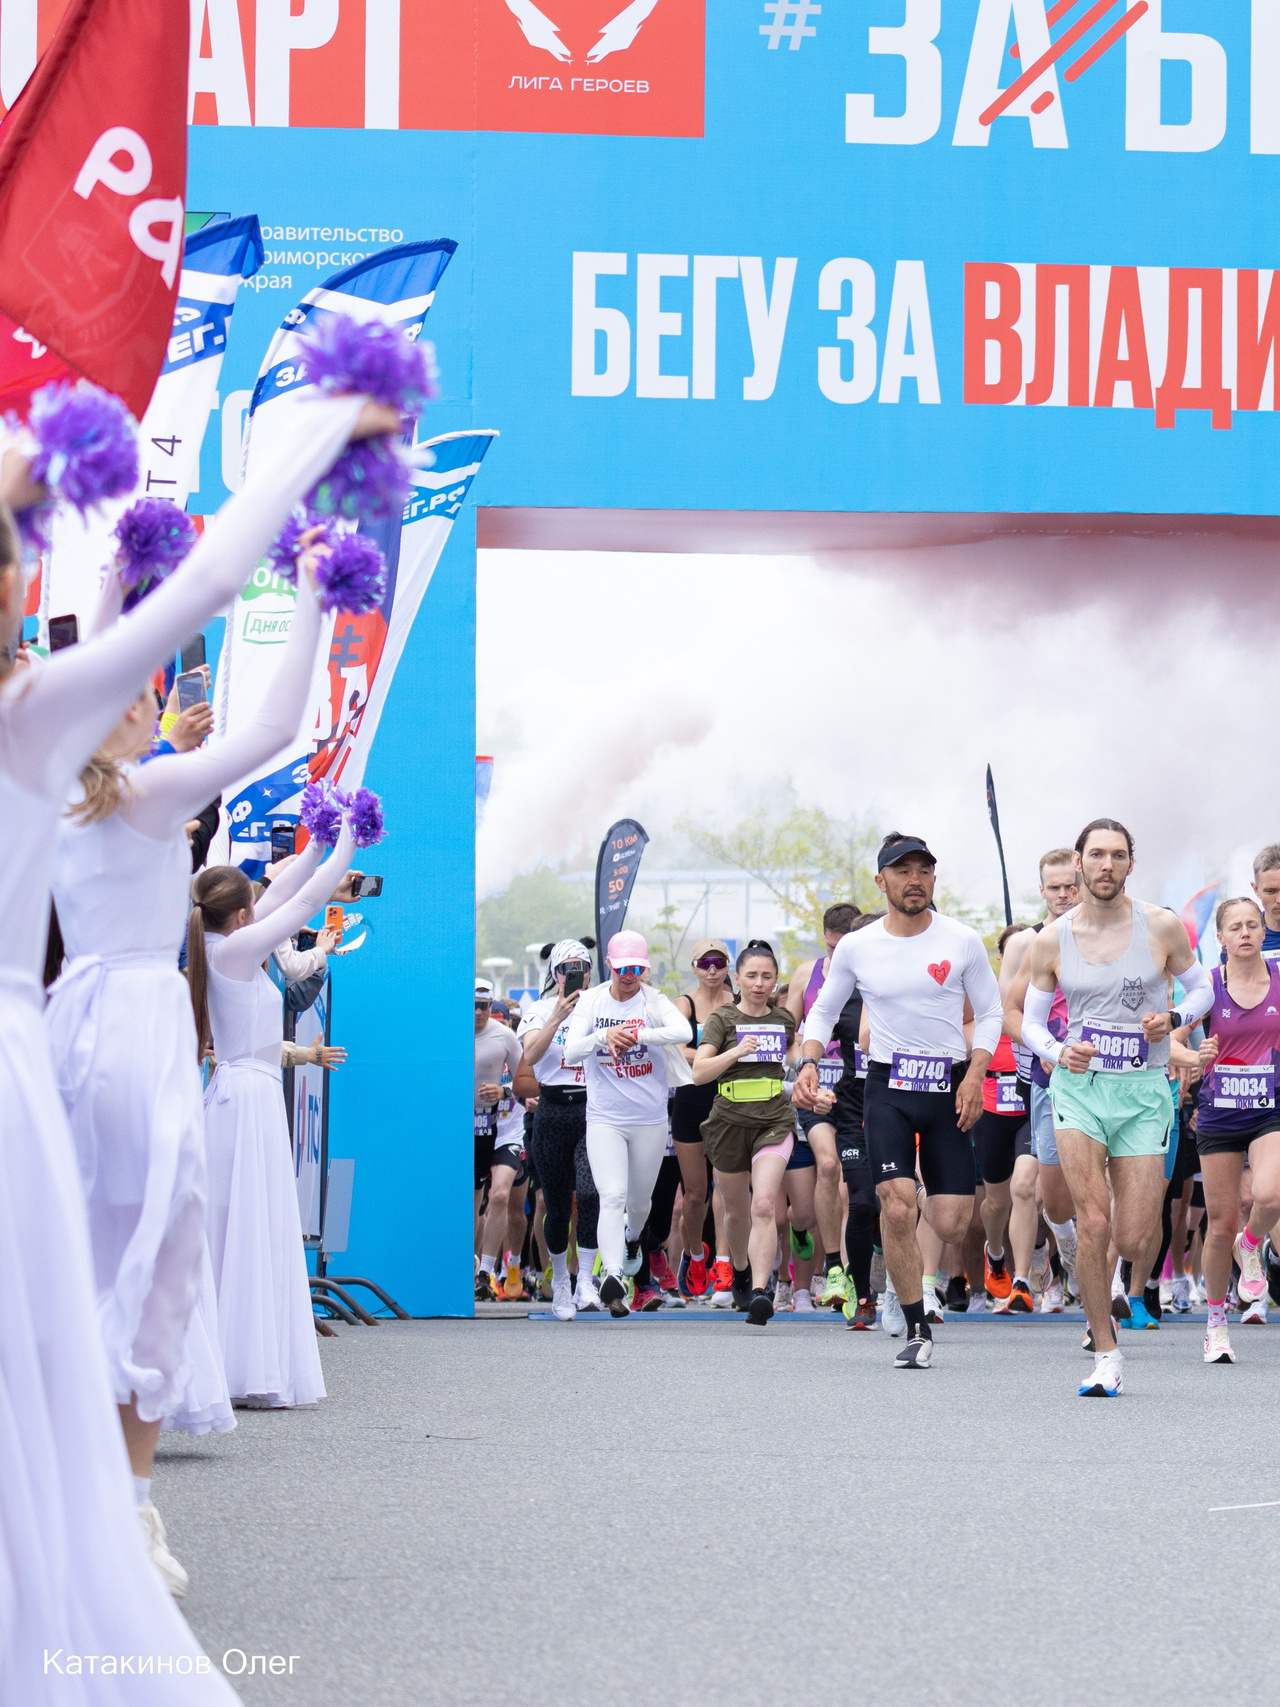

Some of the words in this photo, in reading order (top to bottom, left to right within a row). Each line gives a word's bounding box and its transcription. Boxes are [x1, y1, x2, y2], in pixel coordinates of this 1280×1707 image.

[508, 75, 563, 91] ЛИГА
[571, 77, 650, 93] ГЕРОЕВ
[262, 225, 404, 244] равительство
[263, 249, 371, 270] риморско
[243, 274, 293, 293] края
[571, 251, 798, 401] БЕГУ
[818, 257, 941, 405] ЗА
[608, 879, 625, 894] 50
[1091, 1033, 1140, 1058] 30816
[623, 1061, 653, 1079] ТОБОЙ
[897, 1058, 946, 1080] 30740
[1221, 1076, 1268, 1097] 30034
